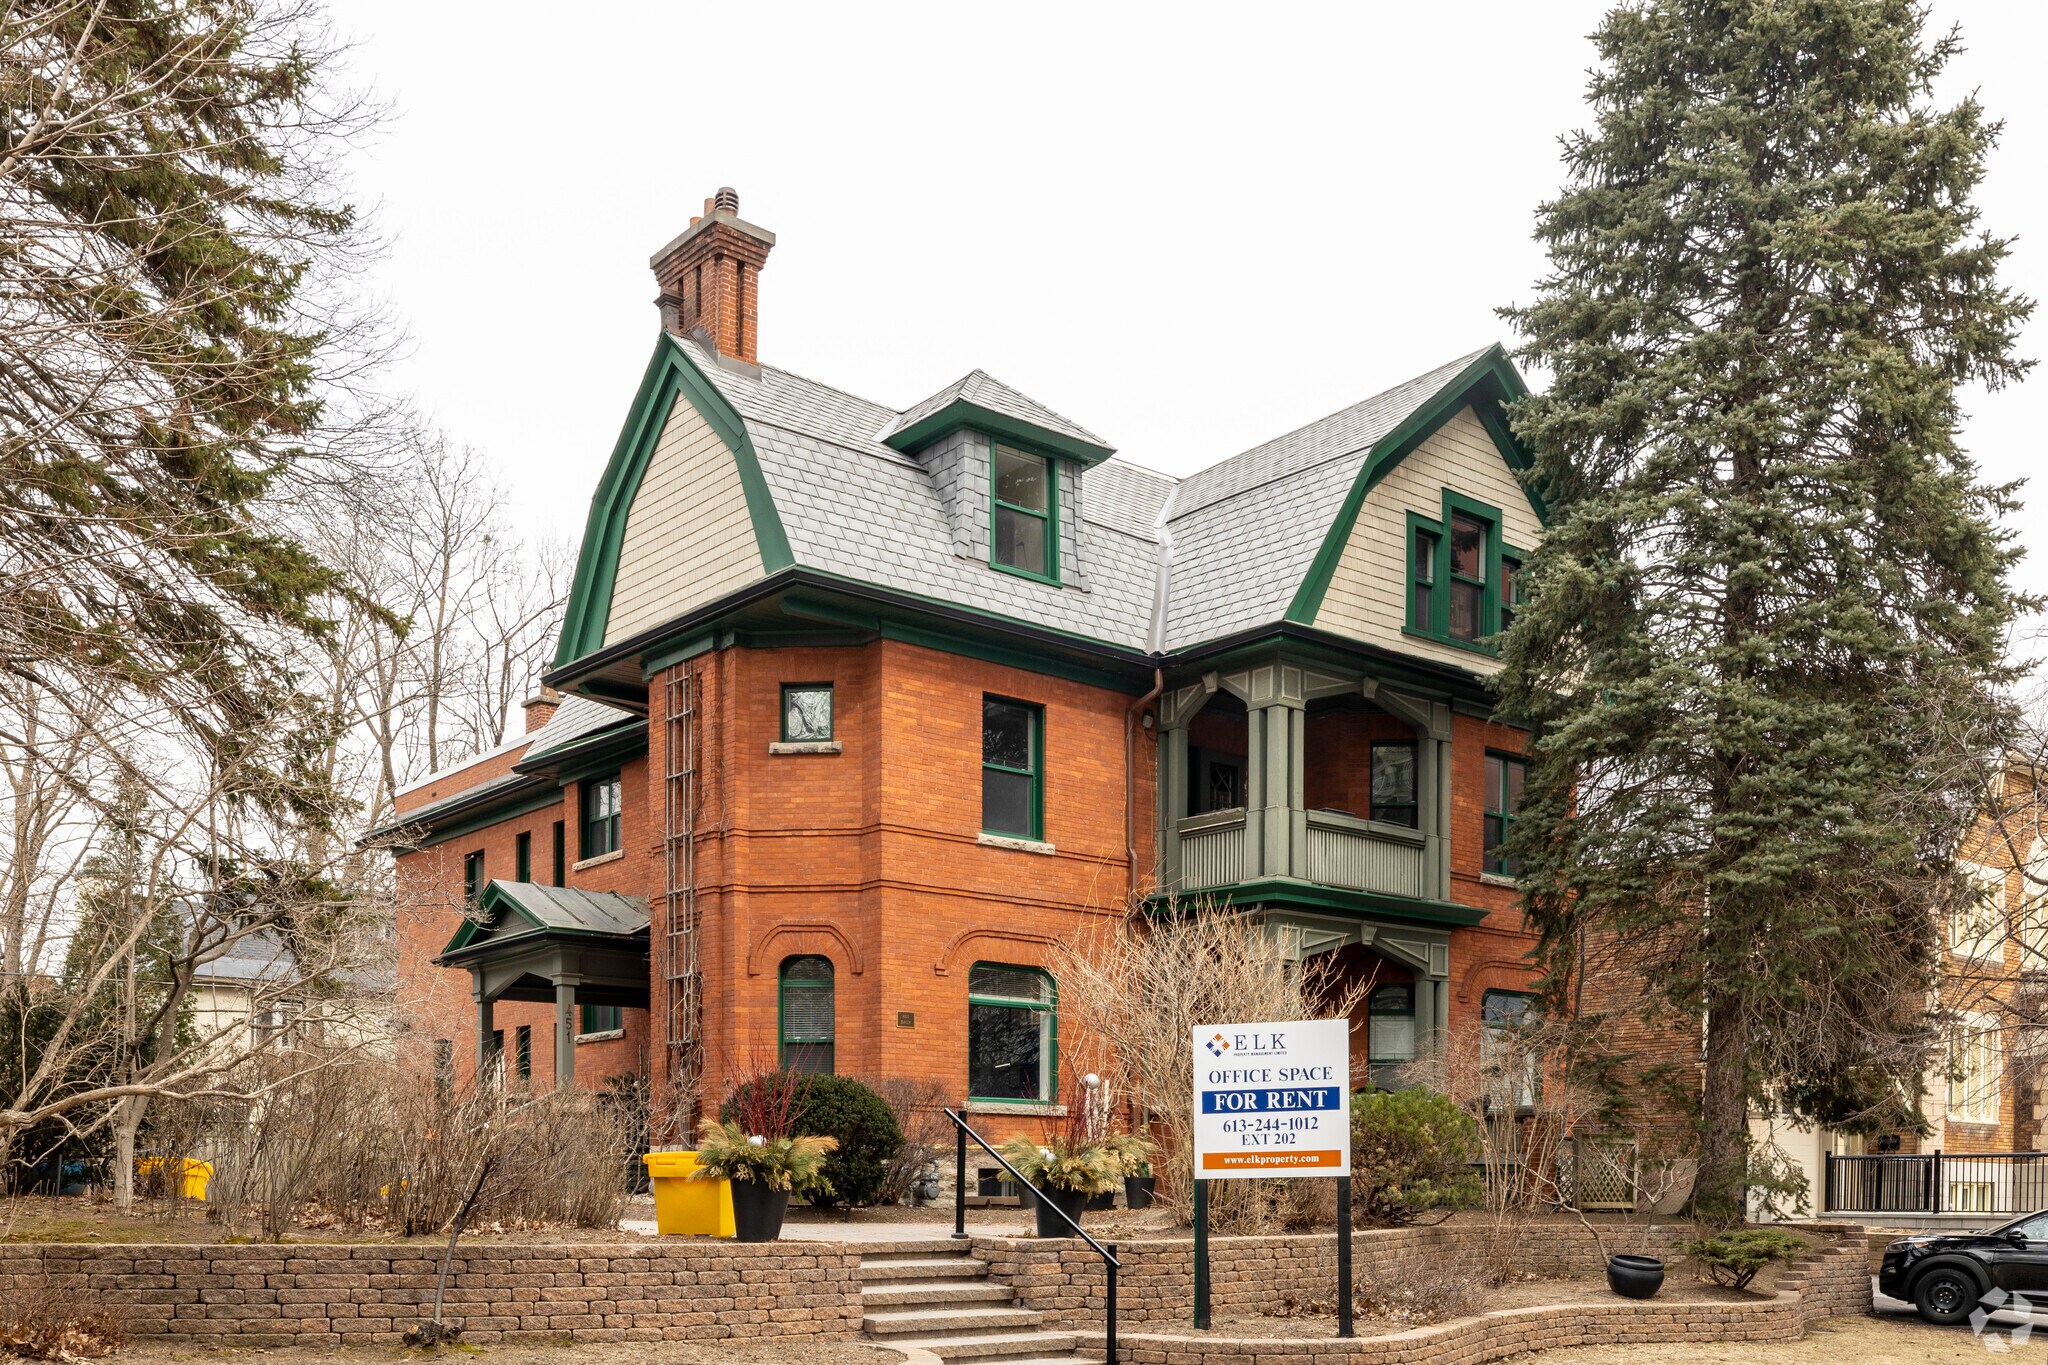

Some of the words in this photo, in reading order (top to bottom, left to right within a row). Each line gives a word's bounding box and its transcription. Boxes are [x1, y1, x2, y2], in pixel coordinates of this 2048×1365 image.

[1234, 1033, 1286, 1050] ELK
[1209, 1069, 1271, 1083] OFFICE
[1278, 1066, 1333, 1081] SPACE
[1214, 1093, 1258, 1110] FOR
[1267, 1090, 1327, 1109] RENT
[1223, 1117, 1318, 1132] 613-244-1012
[1241, 1134, 1270, 1146] EXT
[1274, 1133, 1296, 1145] 202
[1224, 1155, 1319, 1165] www.elkproperty.com
